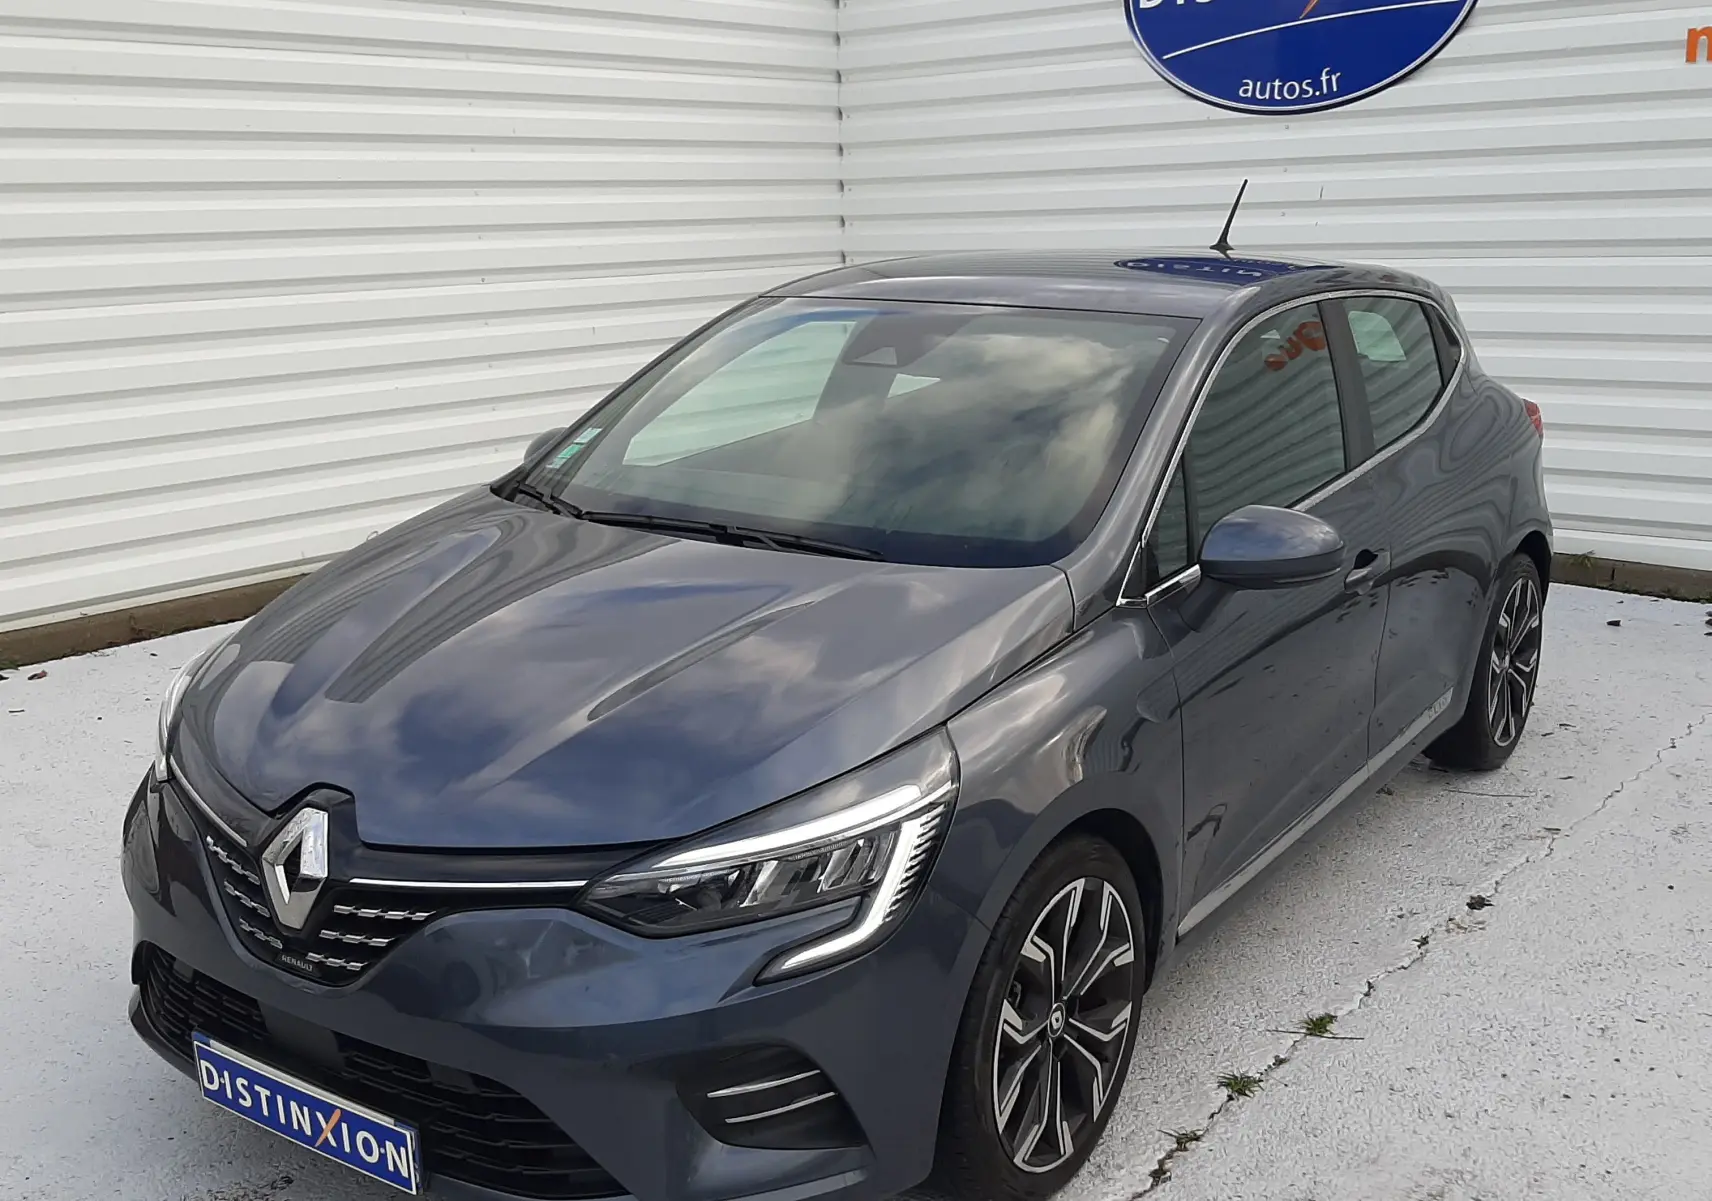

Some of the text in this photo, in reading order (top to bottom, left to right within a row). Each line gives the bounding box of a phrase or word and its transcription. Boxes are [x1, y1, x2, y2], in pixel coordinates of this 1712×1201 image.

[1238, 67, 1341, 100] autos.fr
[281, 954, 313, 972] RENAULT
[200, 1059, 410, 1179] DISTINXION
